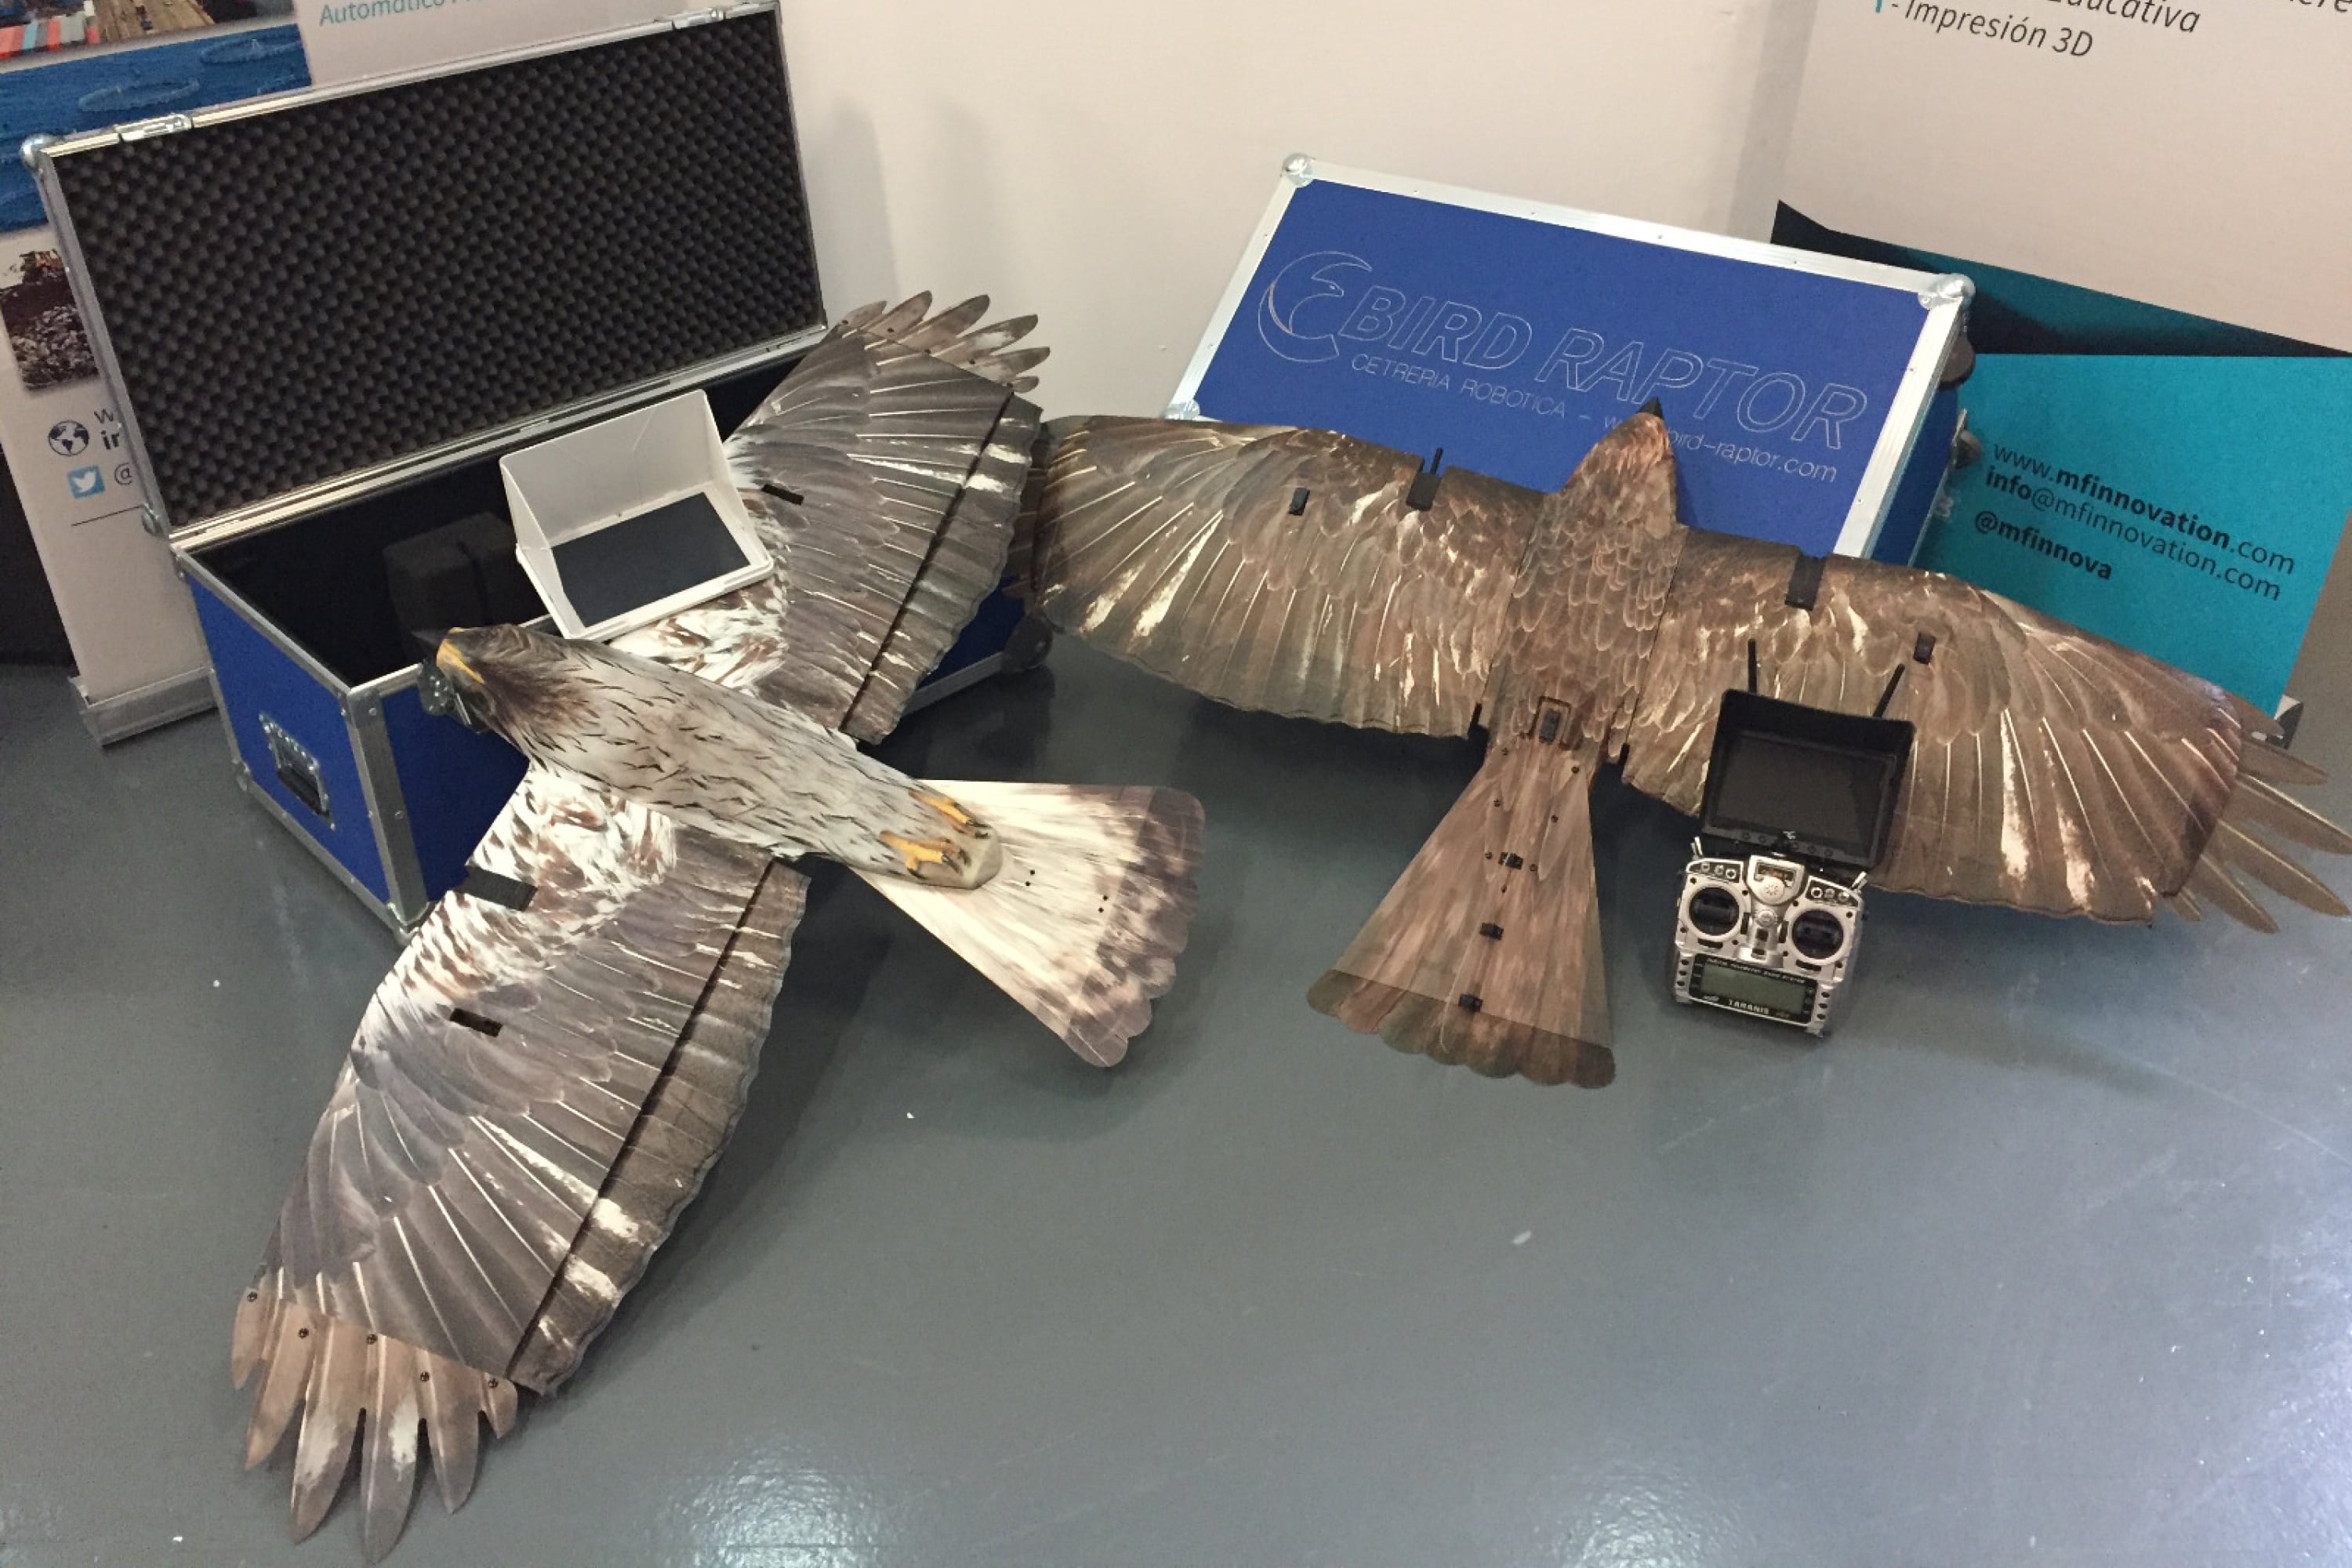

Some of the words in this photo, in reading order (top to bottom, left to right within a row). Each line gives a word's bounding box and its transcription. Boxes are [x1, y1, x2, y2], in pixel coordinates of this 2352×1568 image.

[1904, 0, 2047, 49] Impresión
[2051, 27, 2093, 57] 3D
[2047, 0, 2201, 33] ucativa
[1351, 353, 1450, 391] CETRERIA
[1460, 378, 1566, 419] ROBOTICA
[1534, 327, 1868, 451] RAPTOR
[1985, 465, 2281, 601] info@mfinnovation.com
[1993, 443, 2296, 575] www.mfinnovation.com
[1974, 510, 2114, 581] @mfinnova
